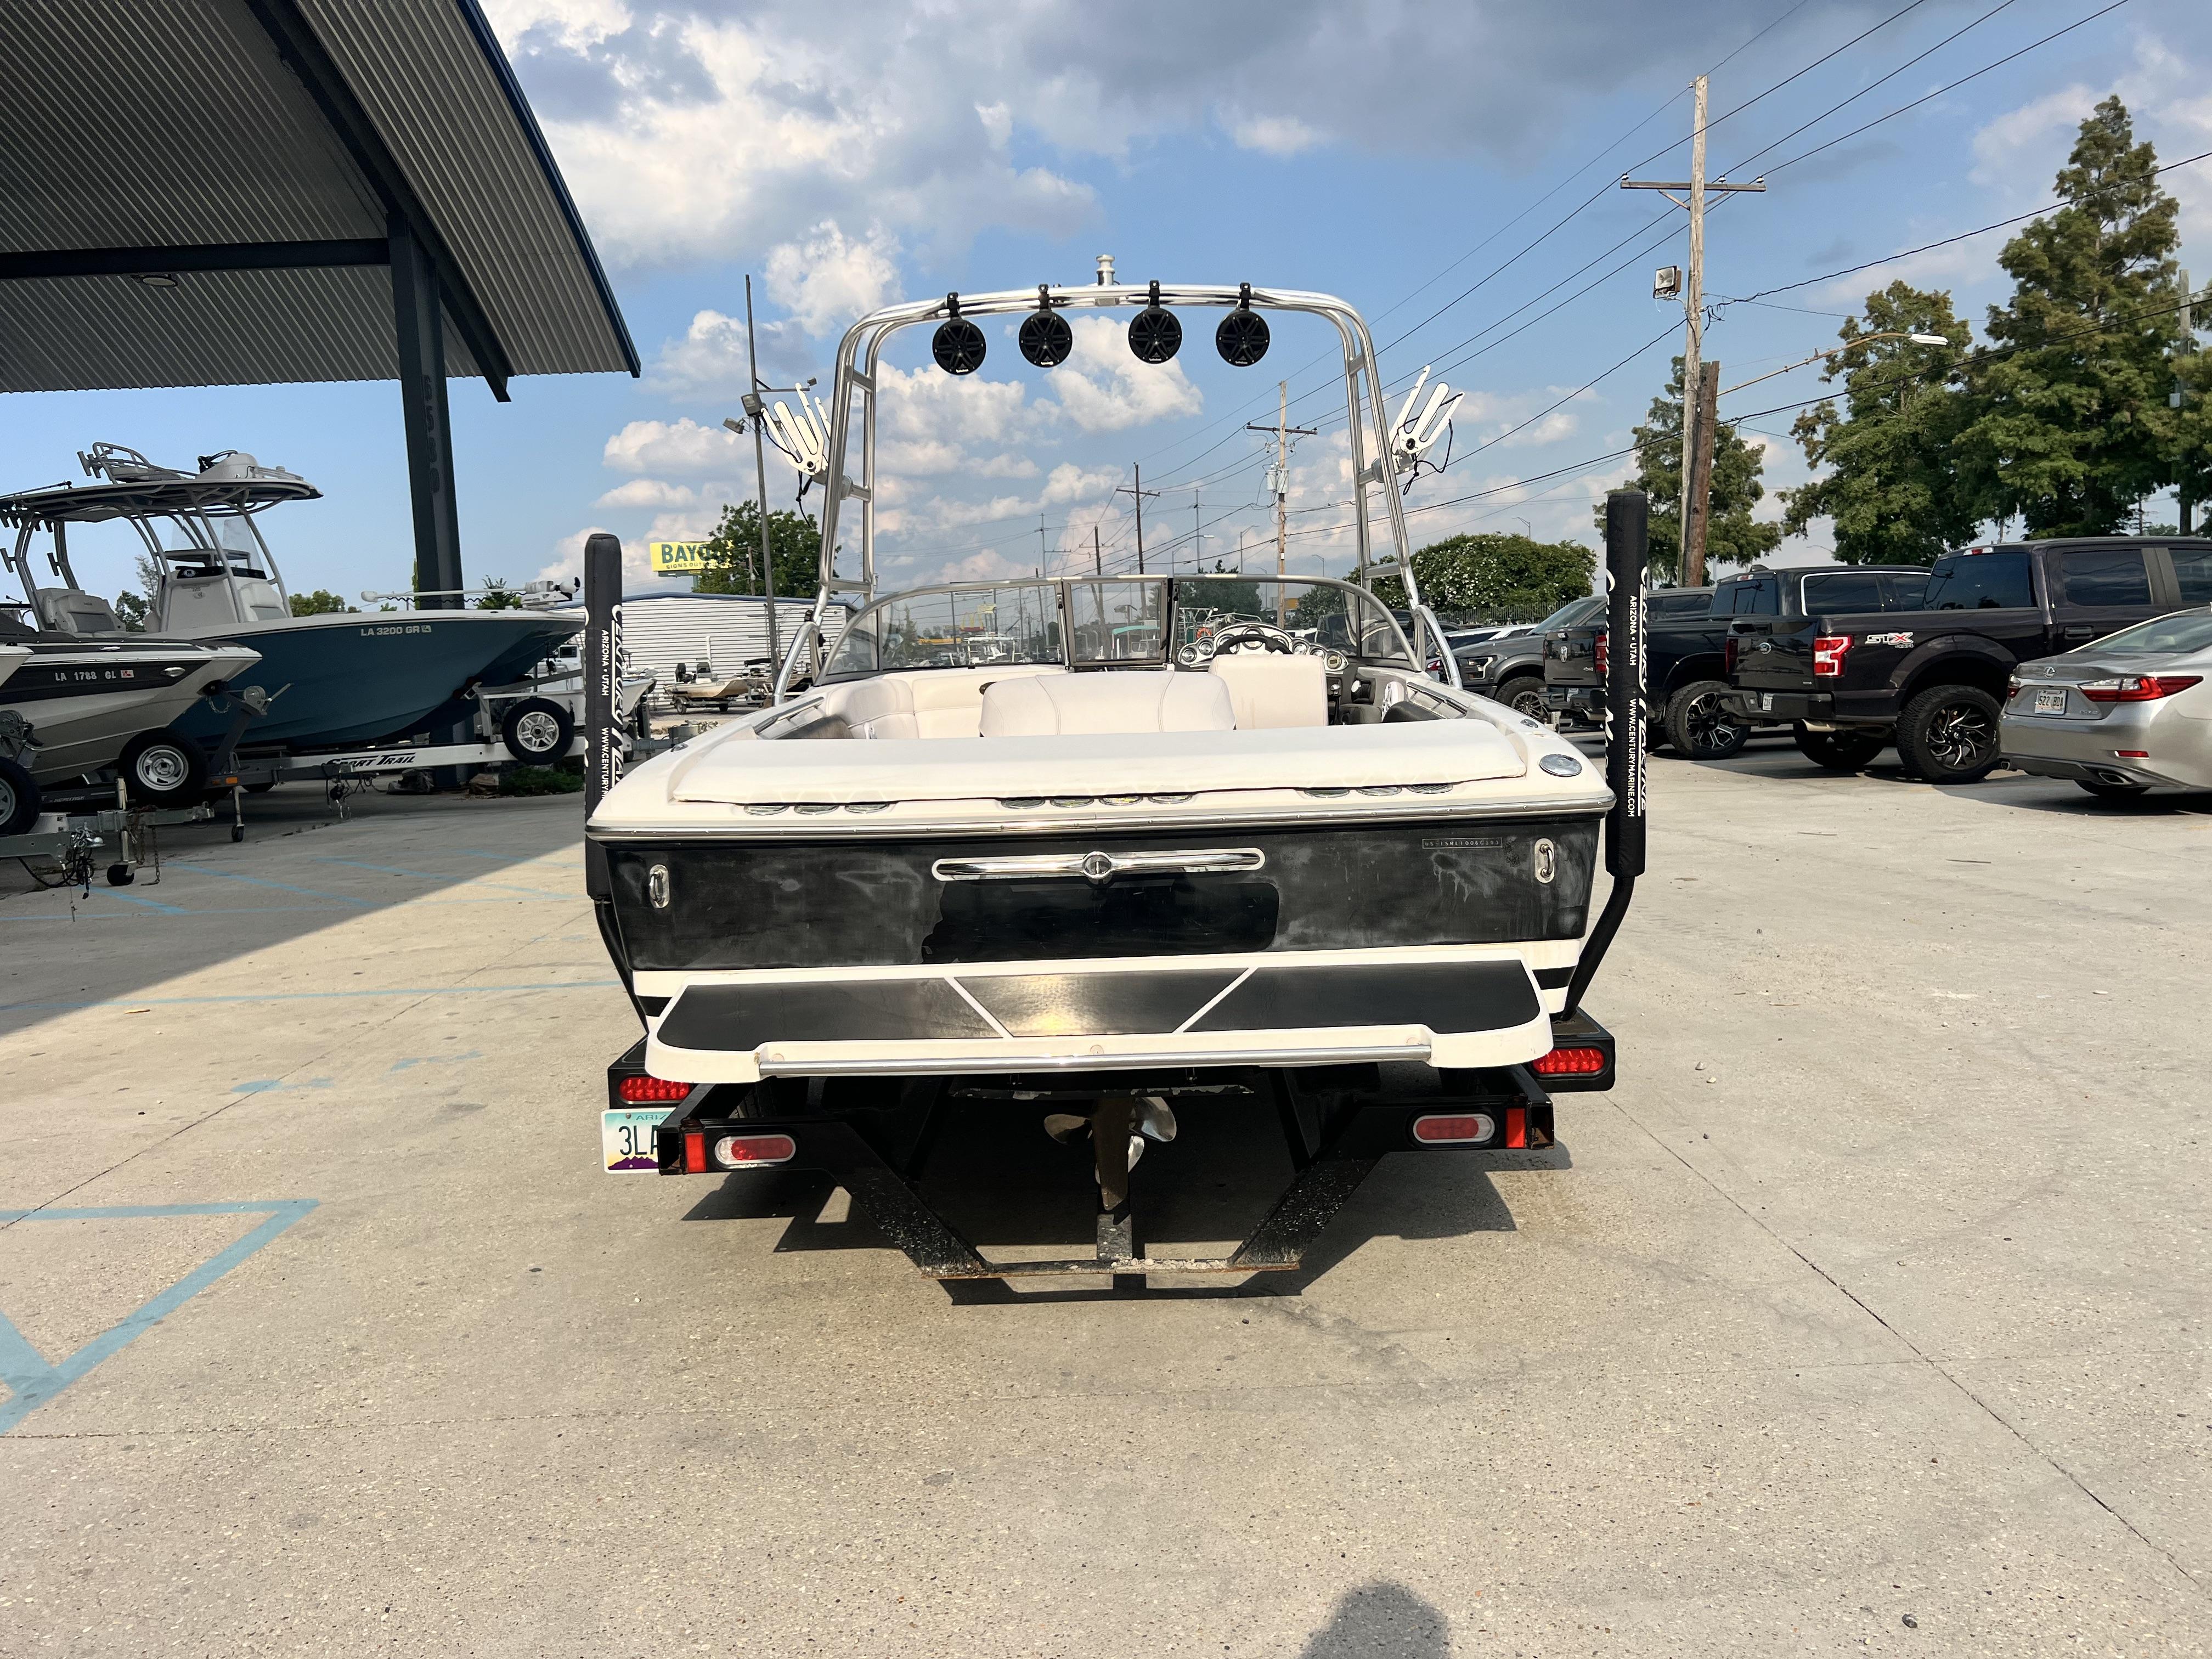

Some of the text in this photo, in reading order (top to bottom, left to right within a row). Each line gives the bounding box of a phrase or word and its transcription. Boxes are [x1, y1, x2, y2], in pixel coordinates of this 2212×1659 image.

[376, 627, 403, 635] 3200
[405, 625, 420, 634] GR
[1865, 632, 1914, 645] STX
[55, 672, 67, 681] LA
[74, 672, 97, 680] 1788
[2039, 696, 2050, 706] 522
[376, 753, 416, 765] TRAIL
[1628, 698, 1637, 817] WWW.CENTURYMARINE.COM
